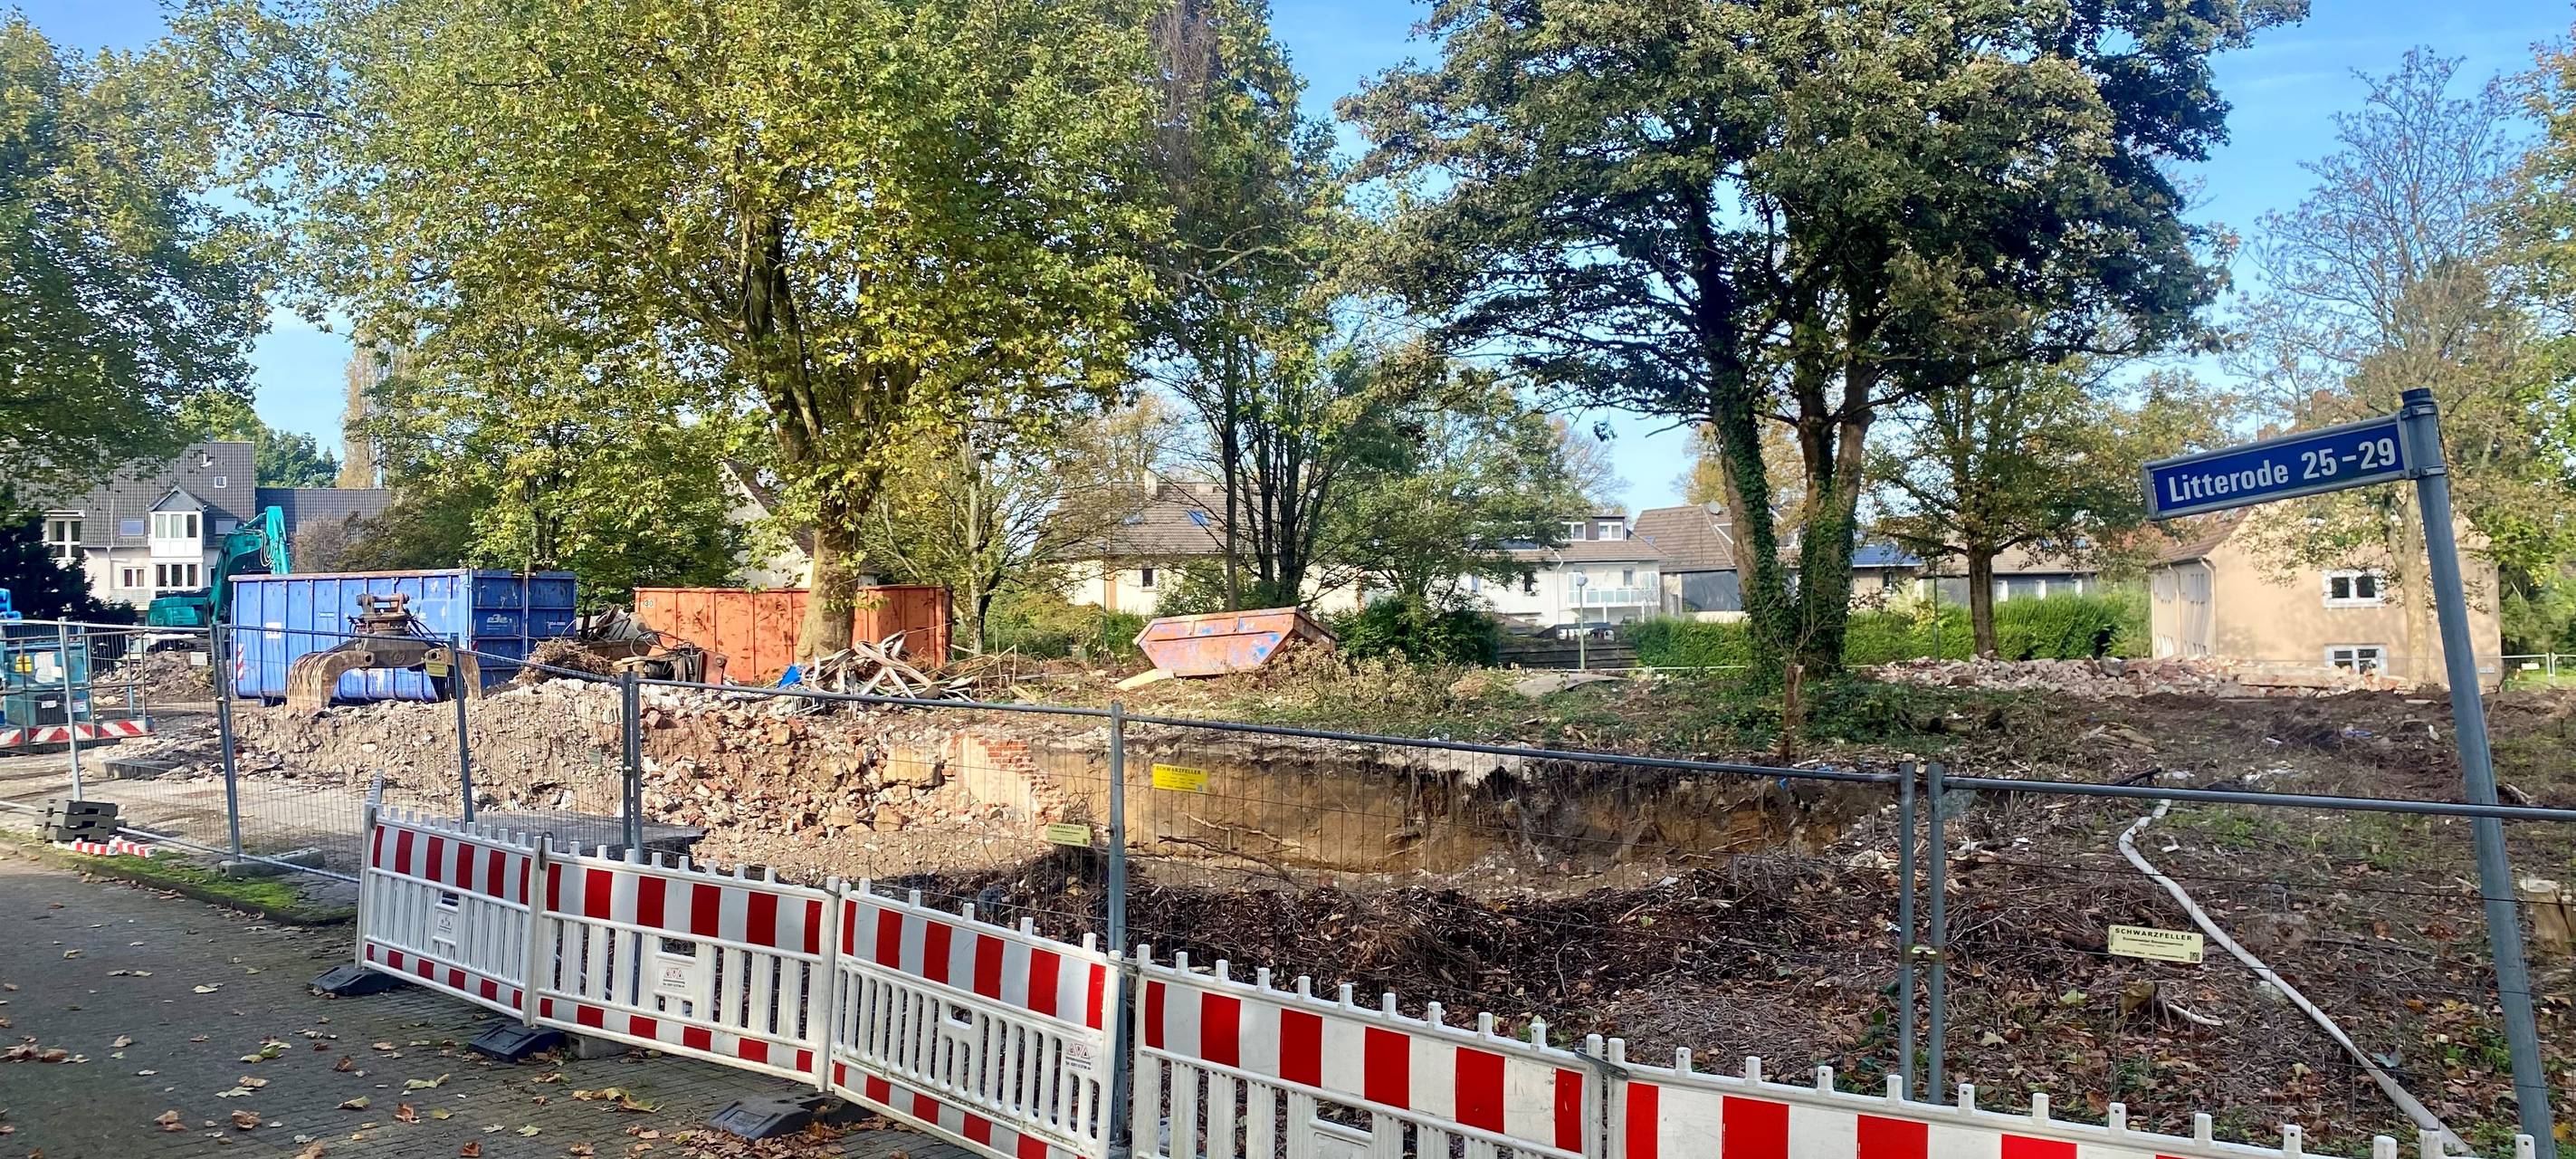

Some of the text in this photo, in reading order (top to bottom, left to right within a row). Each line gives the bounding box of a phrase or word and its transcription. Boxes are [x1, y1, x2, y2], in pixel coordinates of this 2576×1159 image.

[2168, 437, 2397, 503] Litterode 25-29
[2114, 927, 2193, 942] SCHWARZFELLER
